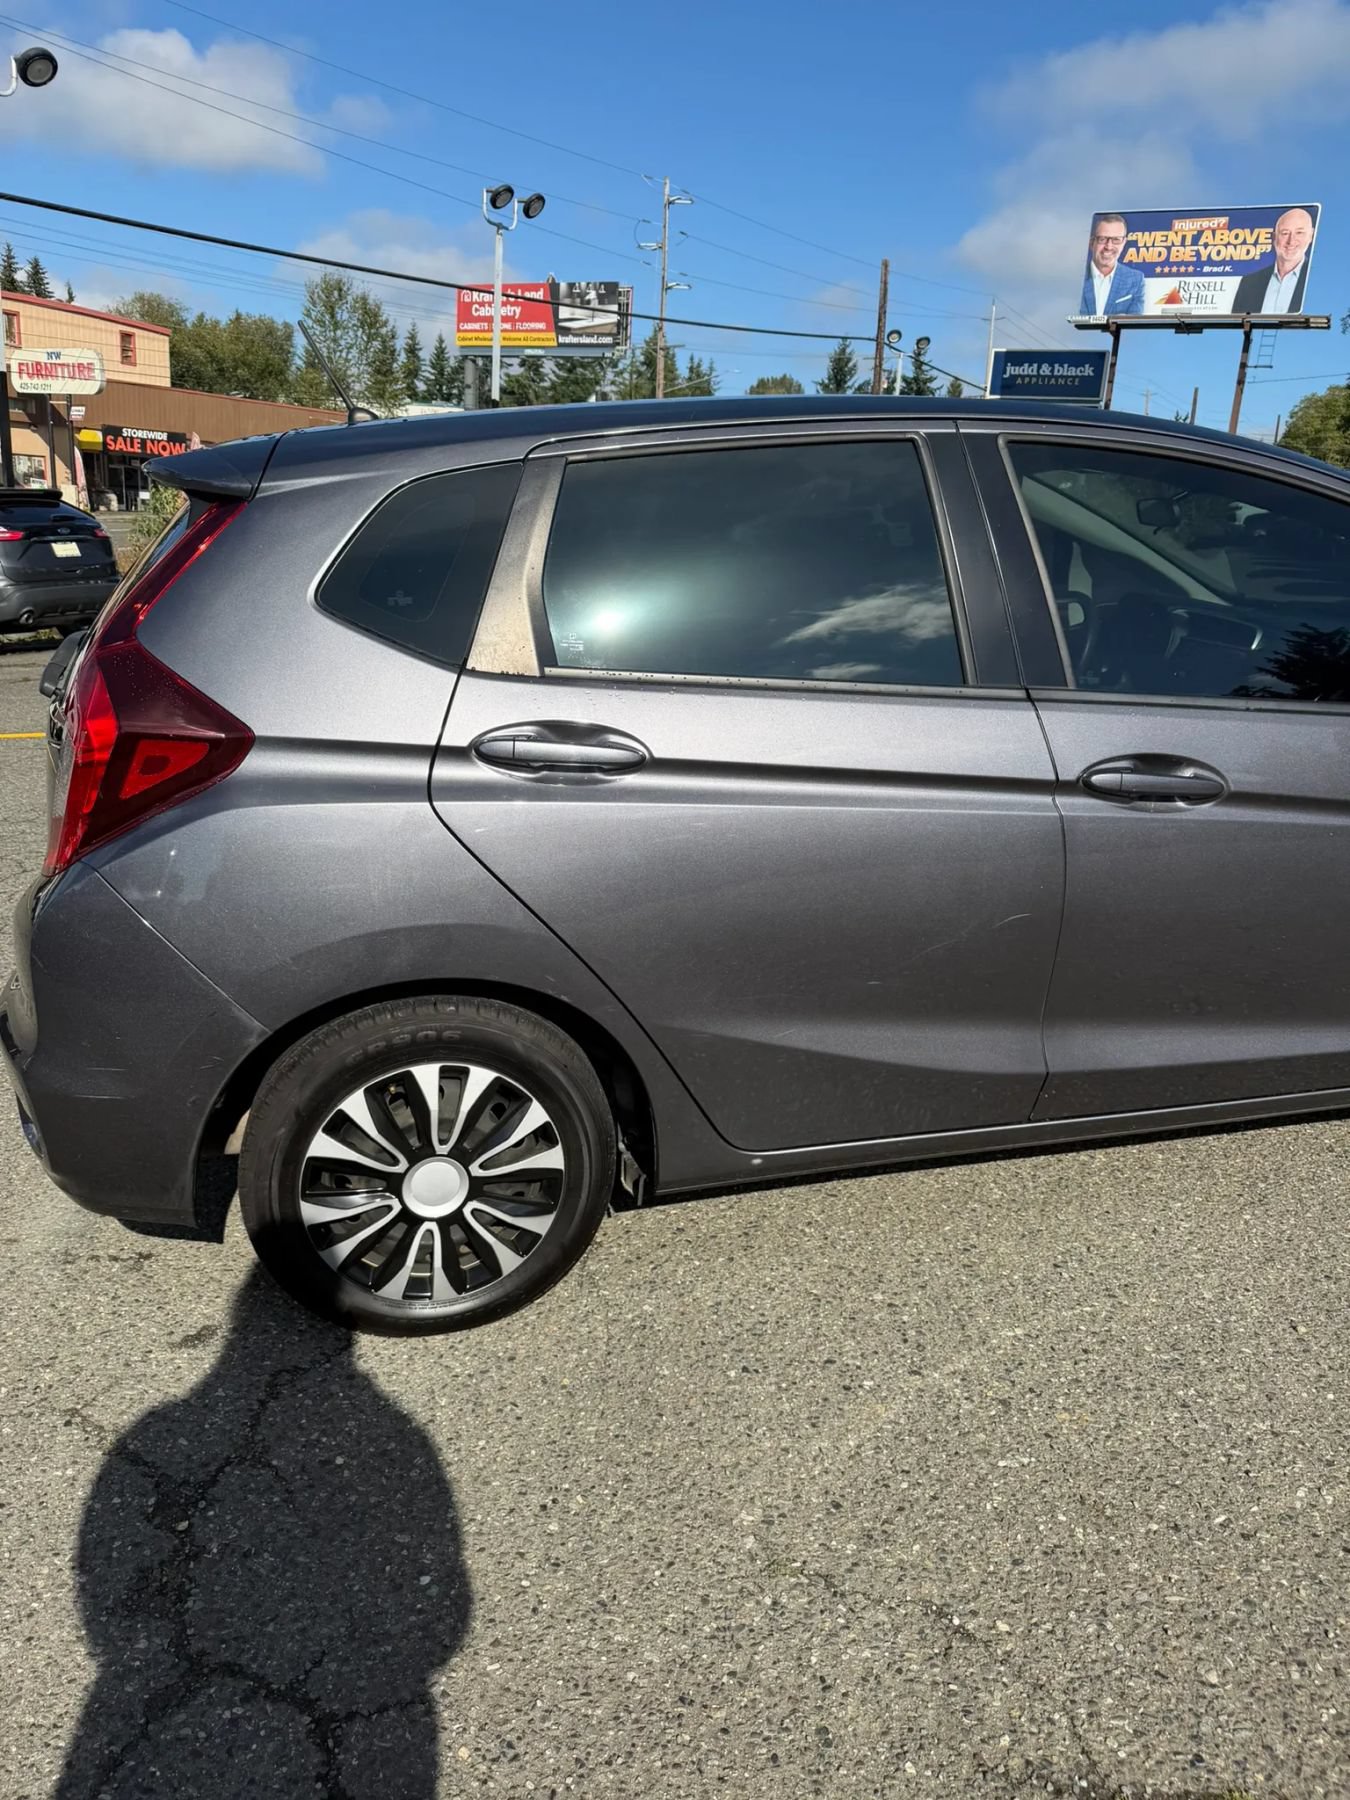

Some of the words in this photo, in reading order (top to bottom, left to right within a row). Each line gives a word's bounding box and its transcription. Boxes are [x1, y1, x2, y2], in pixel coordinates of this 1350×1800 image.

[1174, 219, 1226, 230] Injured?
[1198, 228, 1273, 245] ABOVE
[1123, 247, 1167, 263] AND
[1202, 265, 1224, 273] Brad
[1178, 280, 1226, 293] RUSSELL
[1187, 292, 1217, 305] HILL
[472, 304, 521, 319] Cabietry
[558, 334, 613, 344] kraftersland.com
[46, 352, 62, 360] NW
[17, 362, 96, 380] FURNITURE
[1003, 363, 1038, 378] judd
[1040, 363, 1052, 376] &
[1053, 363, 1095, 376] black
[1016, 377, 1080, 386] APPLIANCE
[122, 428, 168, 440] STOREWIDE
[106, 435, 141, 451] SALE
[146, 438, 186, 457] NOW
